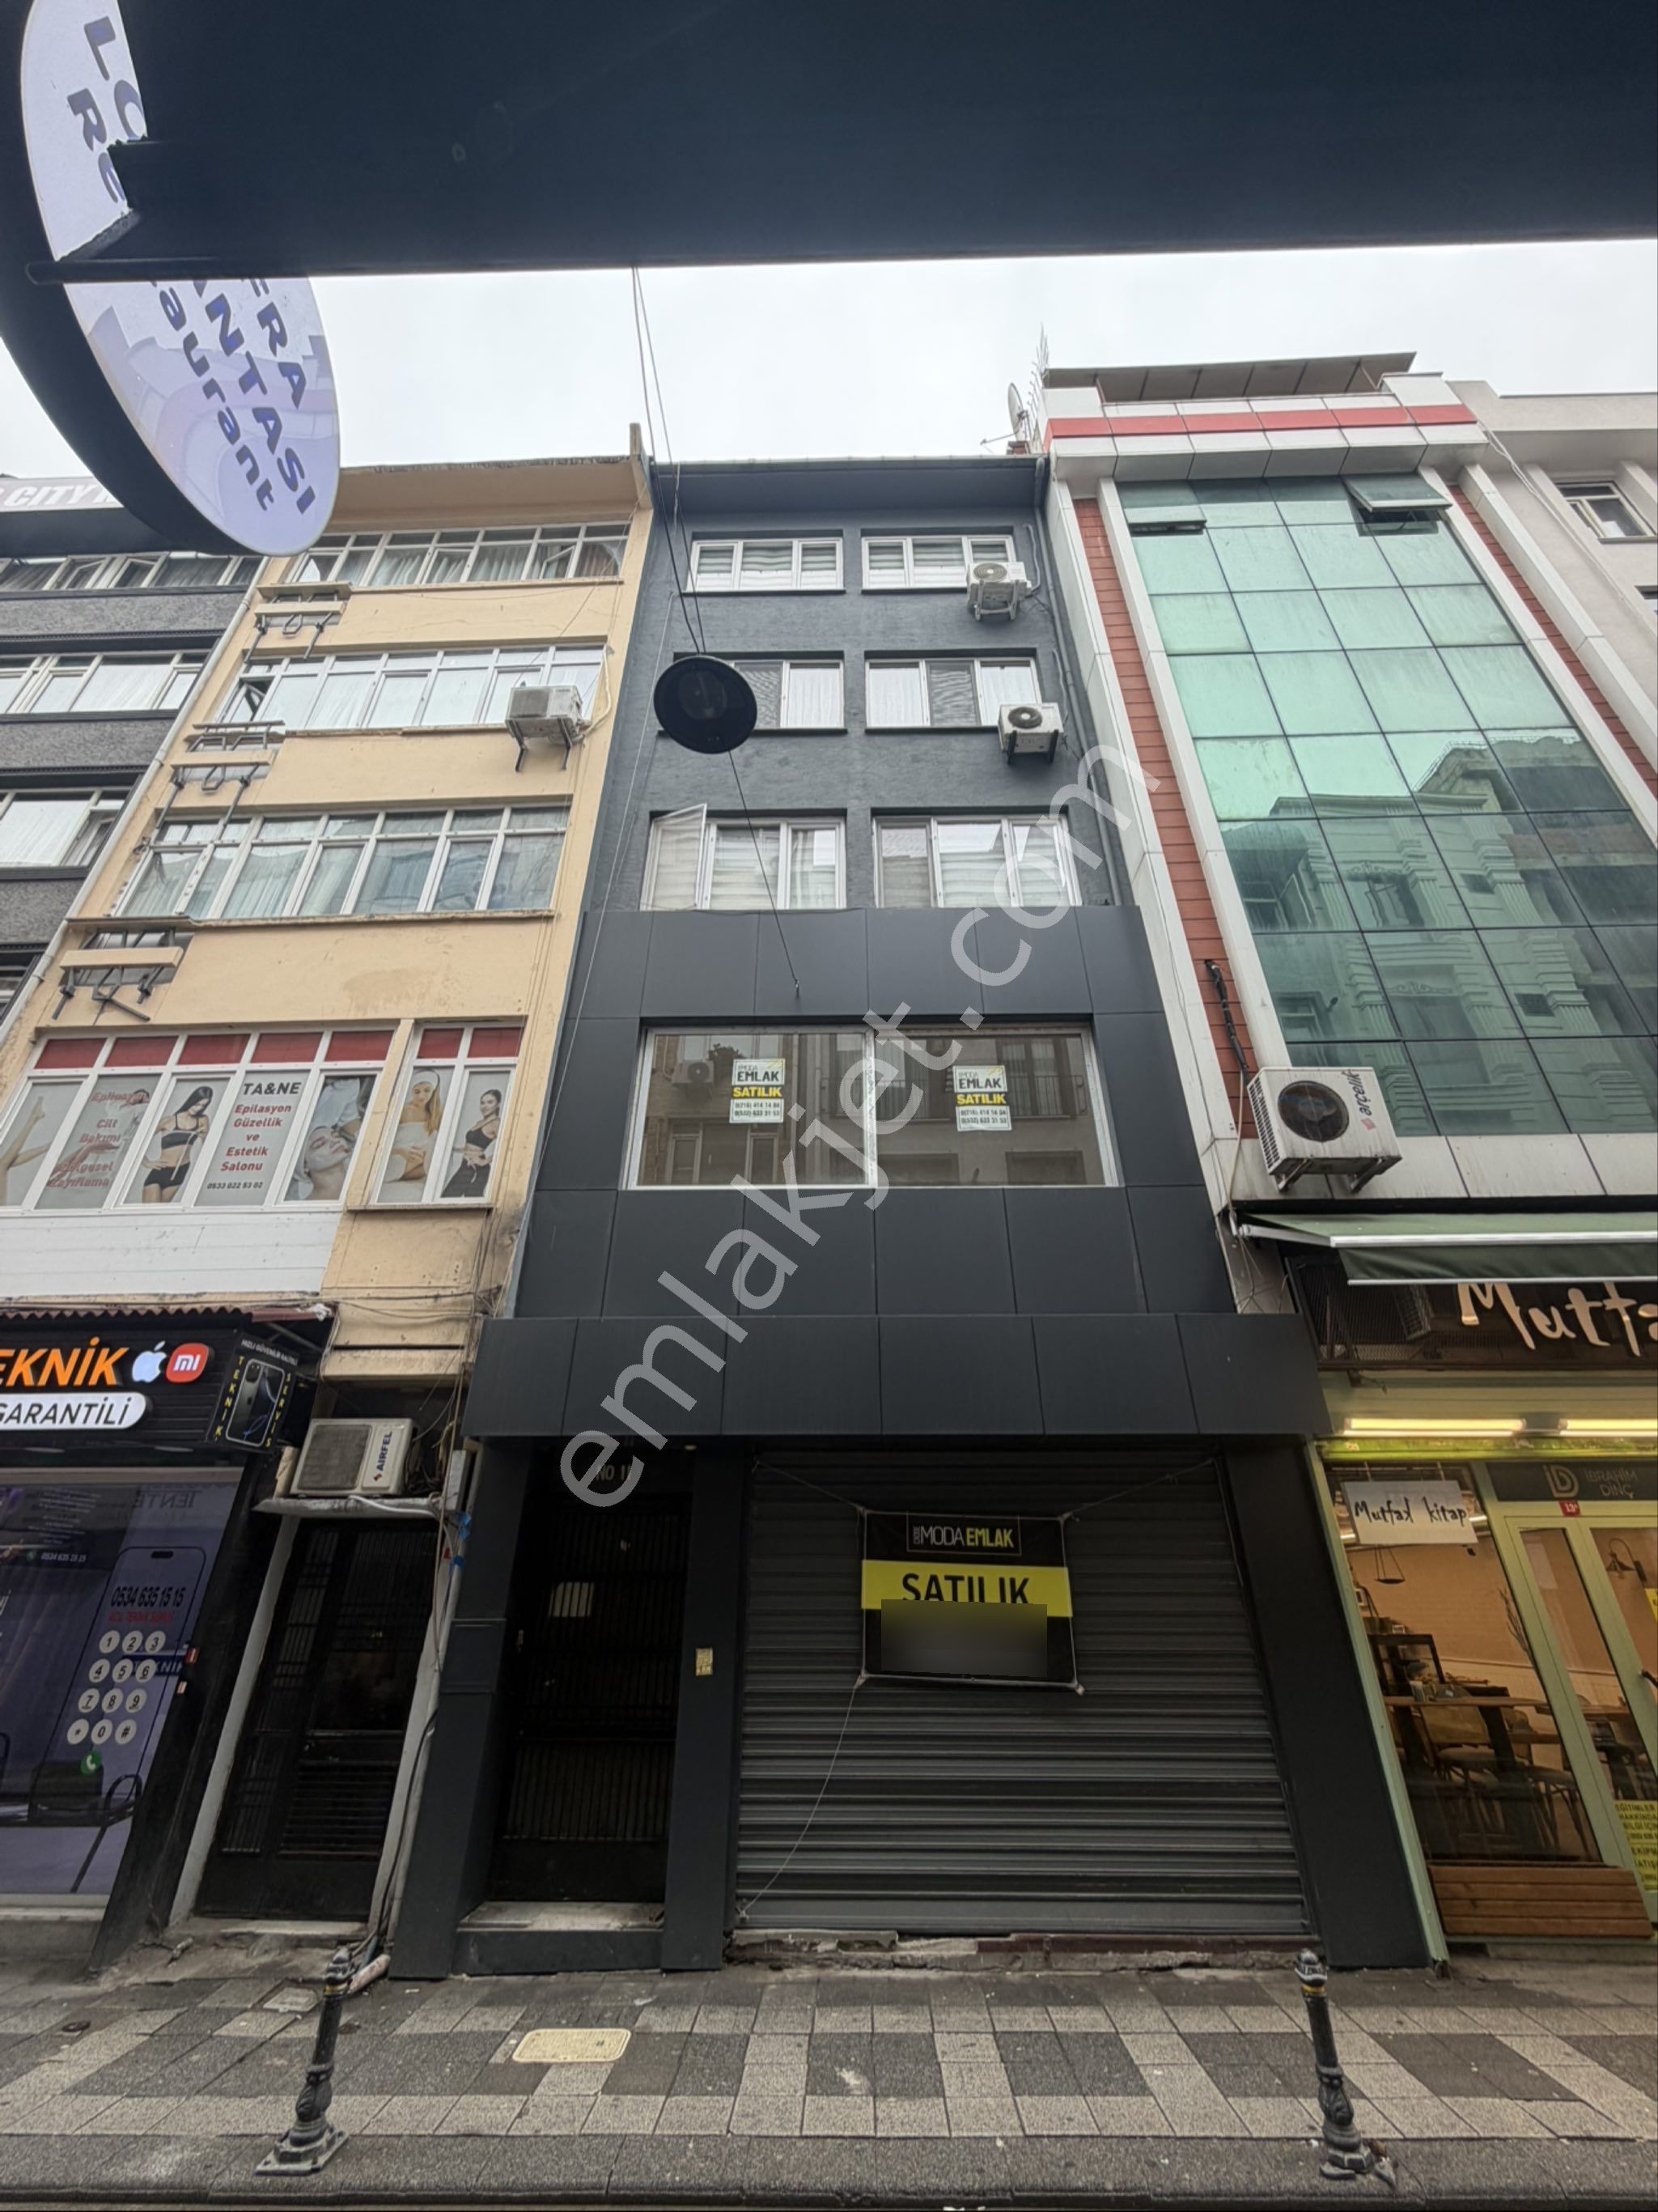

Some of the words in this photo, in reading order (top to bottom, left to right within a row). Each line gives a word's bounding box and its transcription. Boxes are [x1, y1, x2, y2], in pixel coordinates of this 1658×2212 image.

[737, 1071, 779, 1082] EMLAK
[243, 1082, 302, 1096] TA&NE
[959, 1078, 1002, 1089] EMLAK
[733, 1086, 782, 1098] SATILIK
[1342, 1069, 1373, 1117] arçelik
[957, 1093, 1007, 1106] SATILIK
[235, 1104, 292, 1116] Epilasyon
[96, 1119, 118, 1129] Cilt
[233, 1118, 283, 1128] Güzellik
[246, 1134, 260, 1142] ve
[226, 1146, 269, 1157] Estetik
[220, 1161, 264, 1172] Salonu
[376, 1431, 393, 1472] AIRFEL
[1354, 1497, 1414, 1525] Mutfak
[1422, 1496, 1468, 1527] kitap
[921, 1526, 965, 1547] MODA
[966, 1527, 1015, 1548] EMLAK
[902, 1573, 1030, 1603] SATILIK
